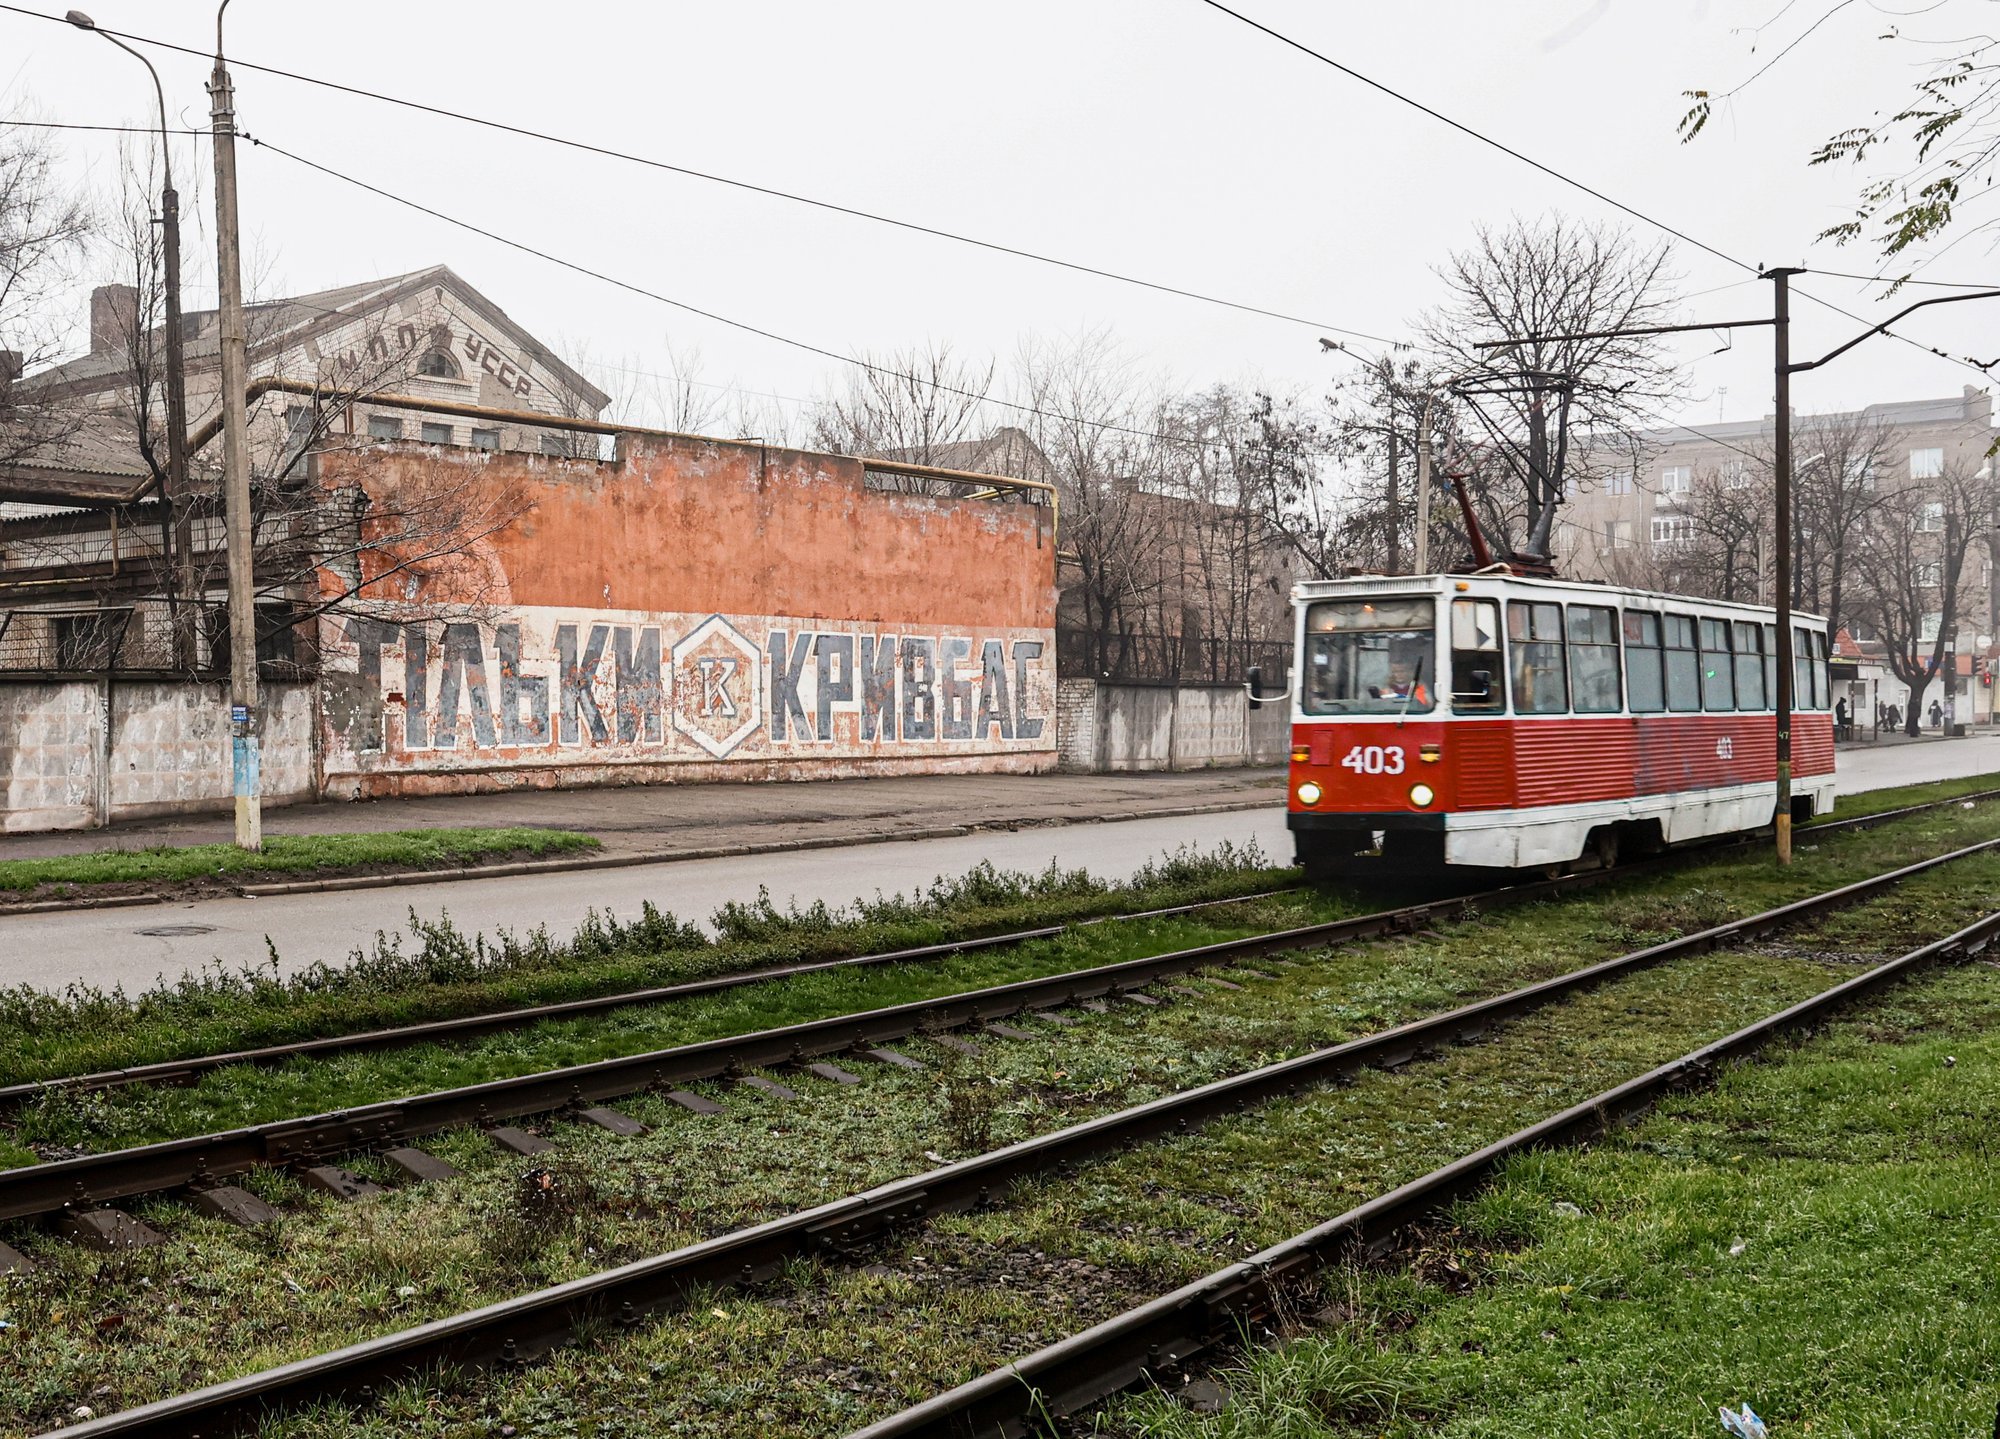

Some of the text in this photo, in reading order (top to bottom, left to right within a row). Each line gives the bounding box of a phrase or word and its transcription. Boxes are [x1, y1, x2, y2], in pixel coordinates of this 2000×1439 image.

[463, 333, 531, 396] УССР
[766, 630, 1046, 742] КРИВБАС
[1778, 731, 1789, 740] 47
[1341, 745, 1405, 775] 403
